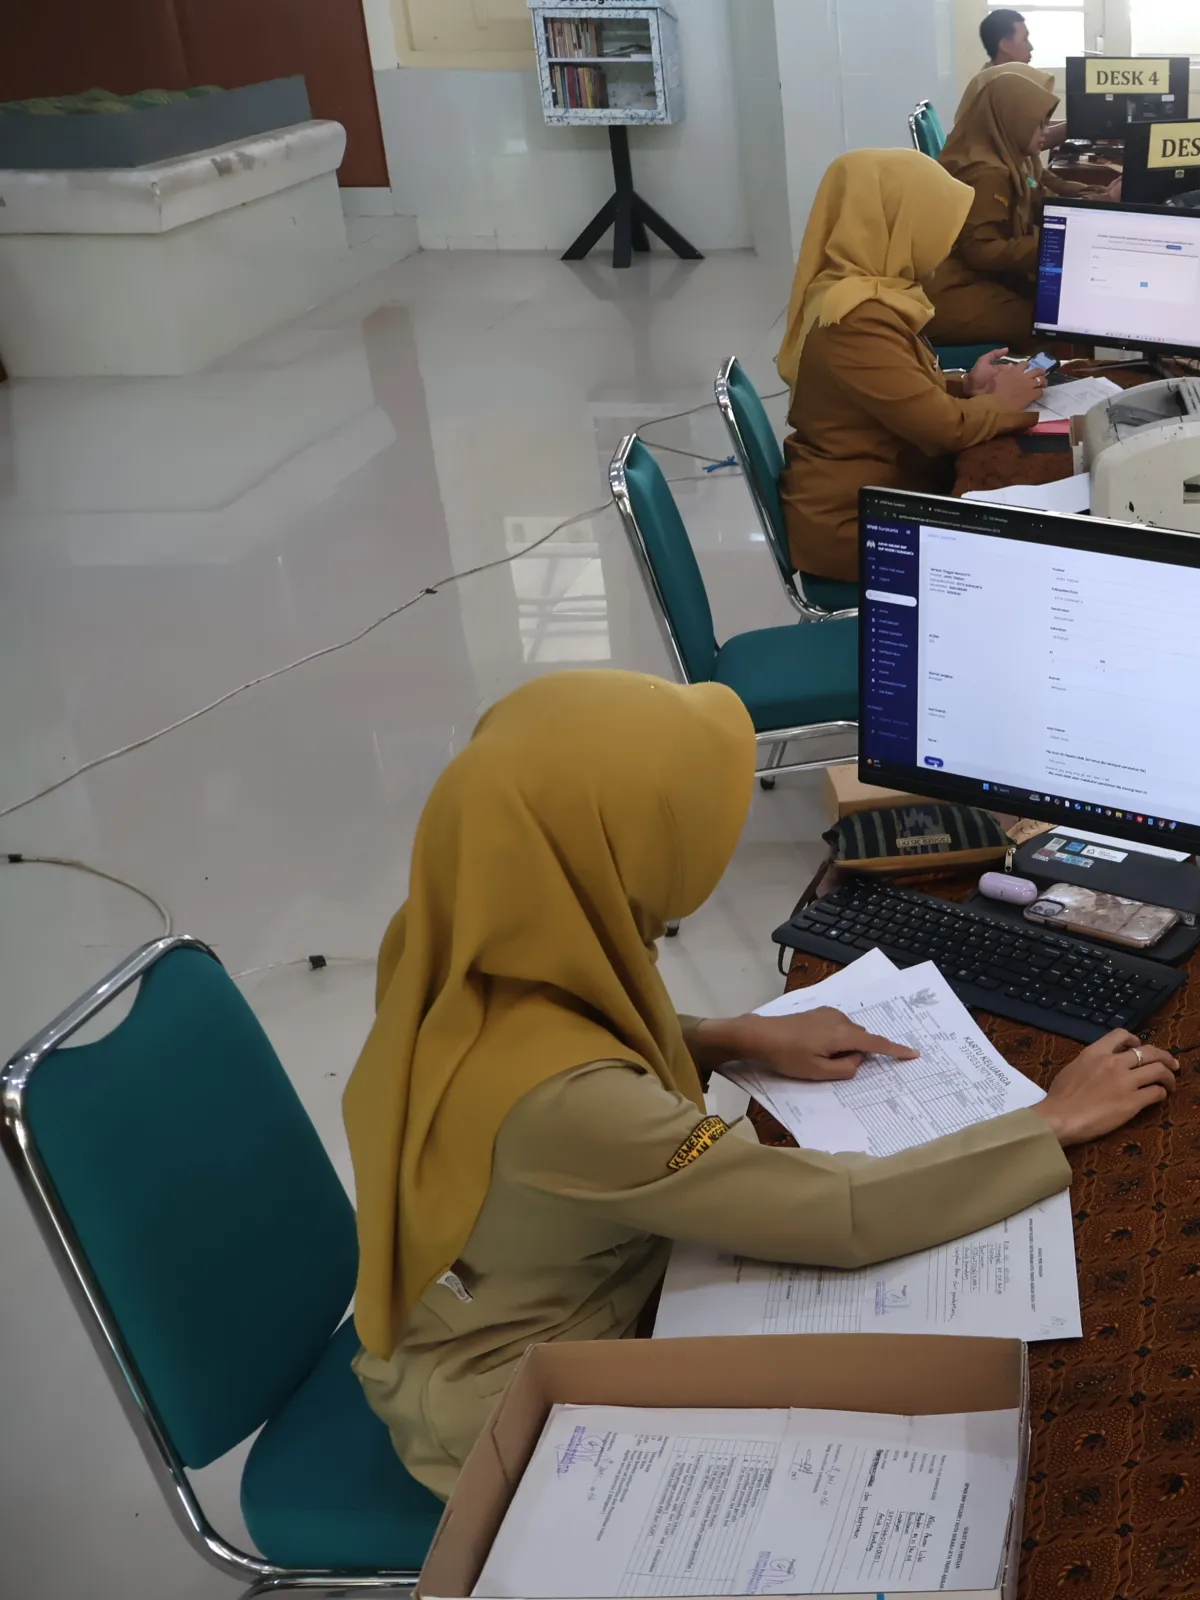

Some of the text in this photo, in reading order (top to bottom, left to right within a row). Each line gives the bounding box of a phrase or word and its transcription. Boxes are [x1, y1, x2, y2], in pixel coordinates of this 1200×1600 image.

[1096, 70, 1160, 86] DESK 4
[963, 1036, 985, 1056] KARTU
[980, 1055, 1011, 1087] KELUARGA
[863, 1492, 873, 1502] dan
